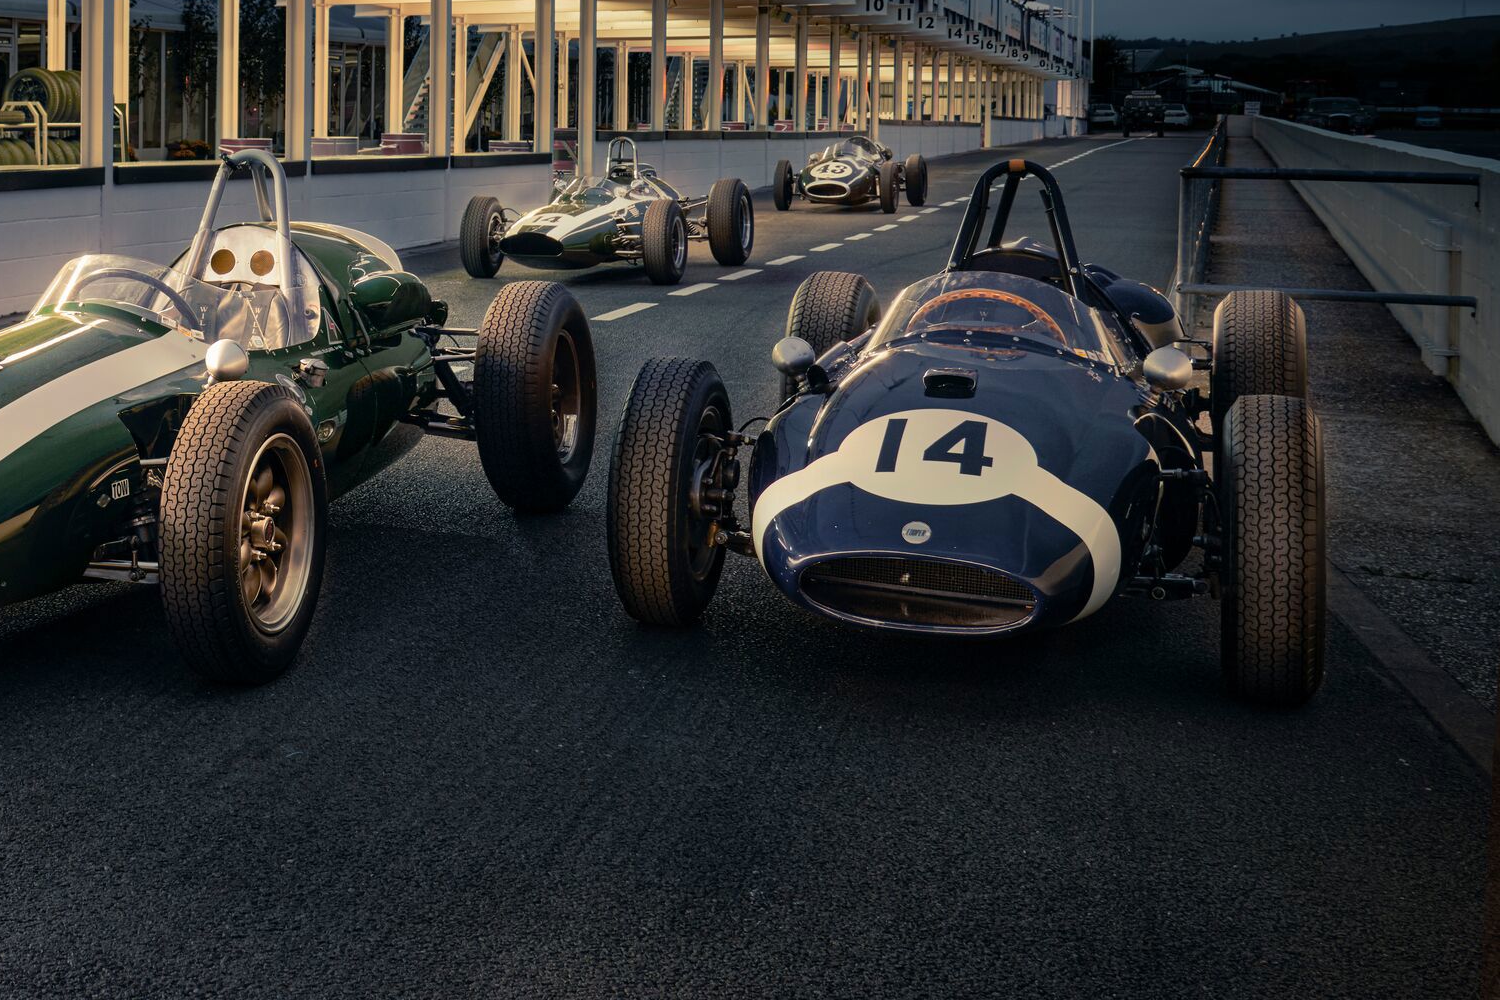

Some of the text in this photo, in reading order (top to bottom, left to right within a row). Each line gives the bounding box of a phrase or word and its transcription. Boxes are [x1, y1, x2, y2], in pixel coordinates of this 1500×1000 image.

[898, 8, 911, 20] 11
[918, 17, 934, 29] 12
[948, 28, 962, 38] 14
[966, 34, 979, 44] 15
[875, 417, 993, 476] 14
[113, 480, 128, 498] TOW
